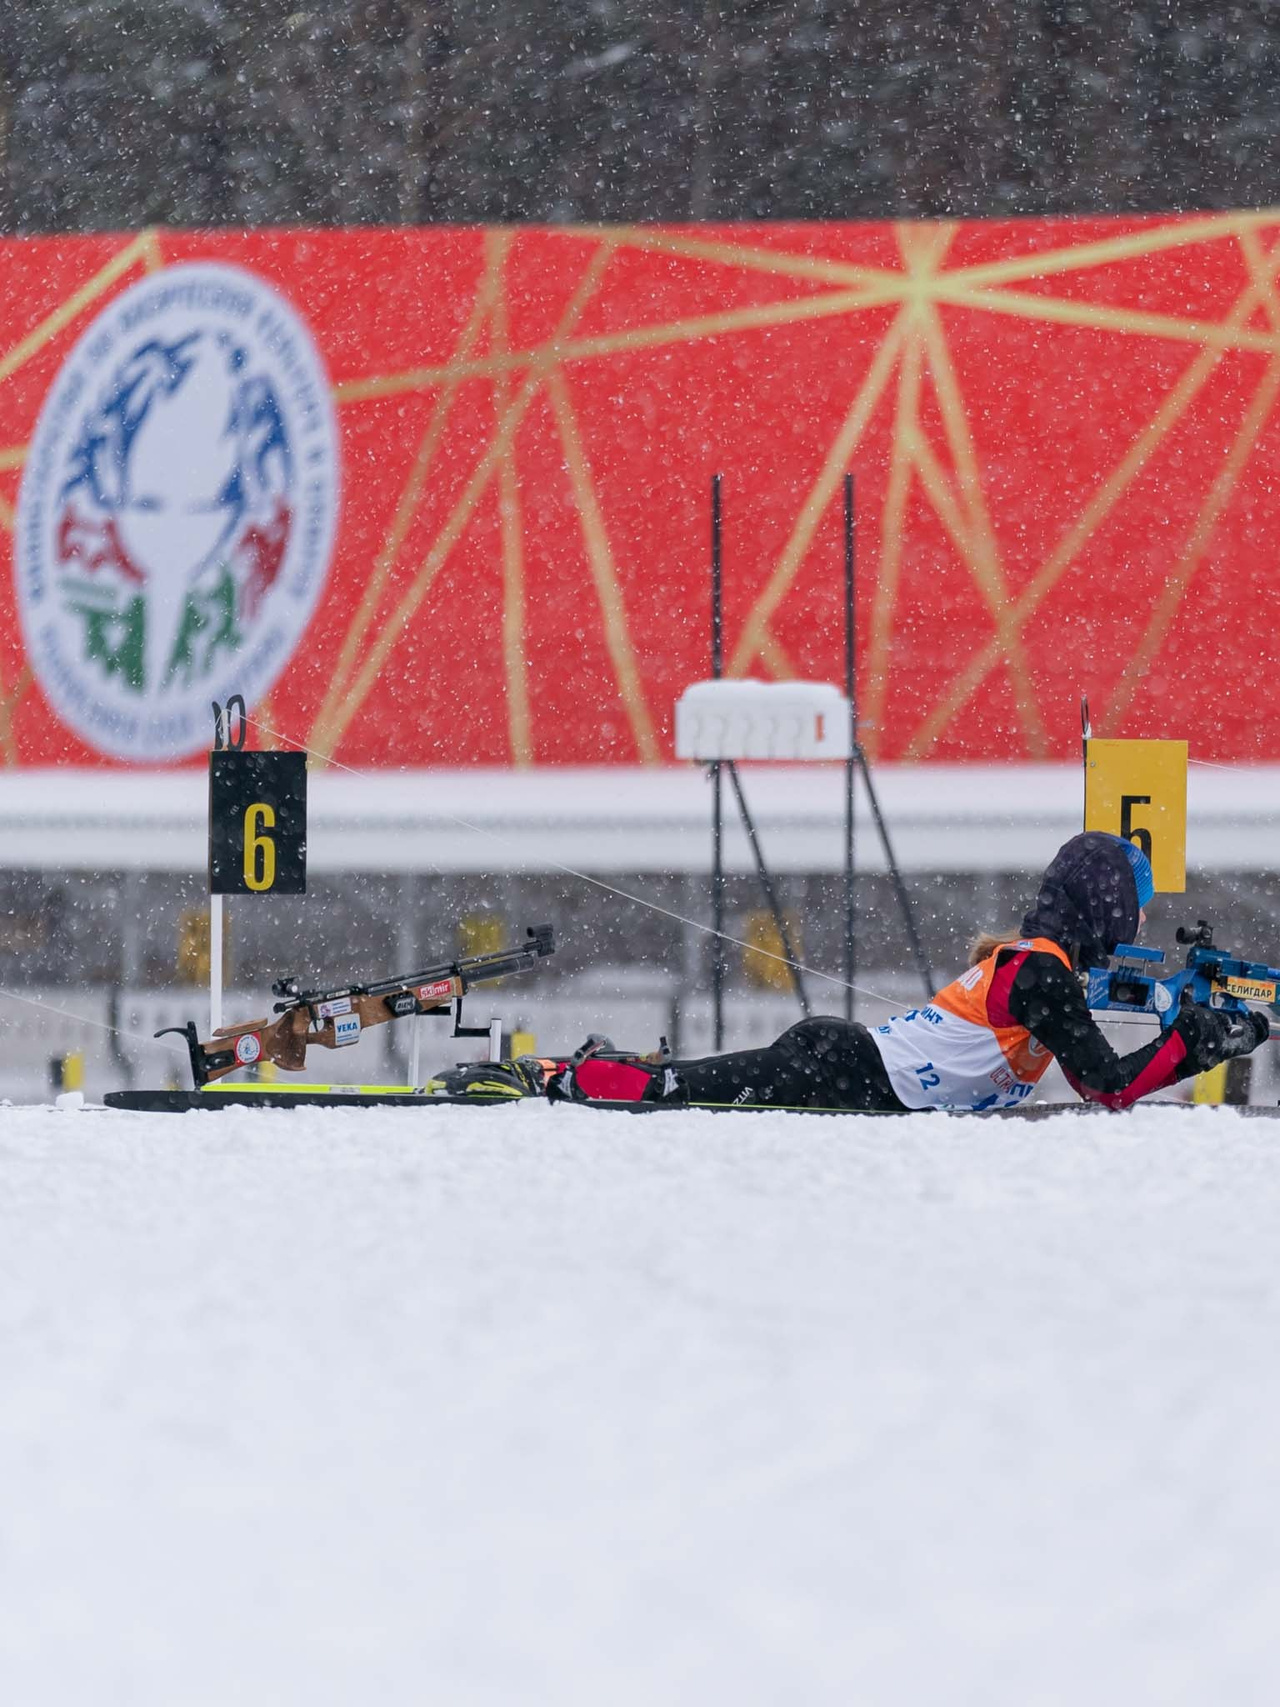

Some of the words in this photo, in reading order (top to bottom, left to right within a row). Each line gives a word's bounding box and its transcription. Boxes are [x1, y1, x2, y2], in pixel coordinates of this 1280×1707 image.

[243, 803, 276, 890] 6
[1225, 983, 1273, 999] СЕЛИГДАР
[337, 1022, 358, 1033] VEKA
[915, 1062, 941, 1091] 12
